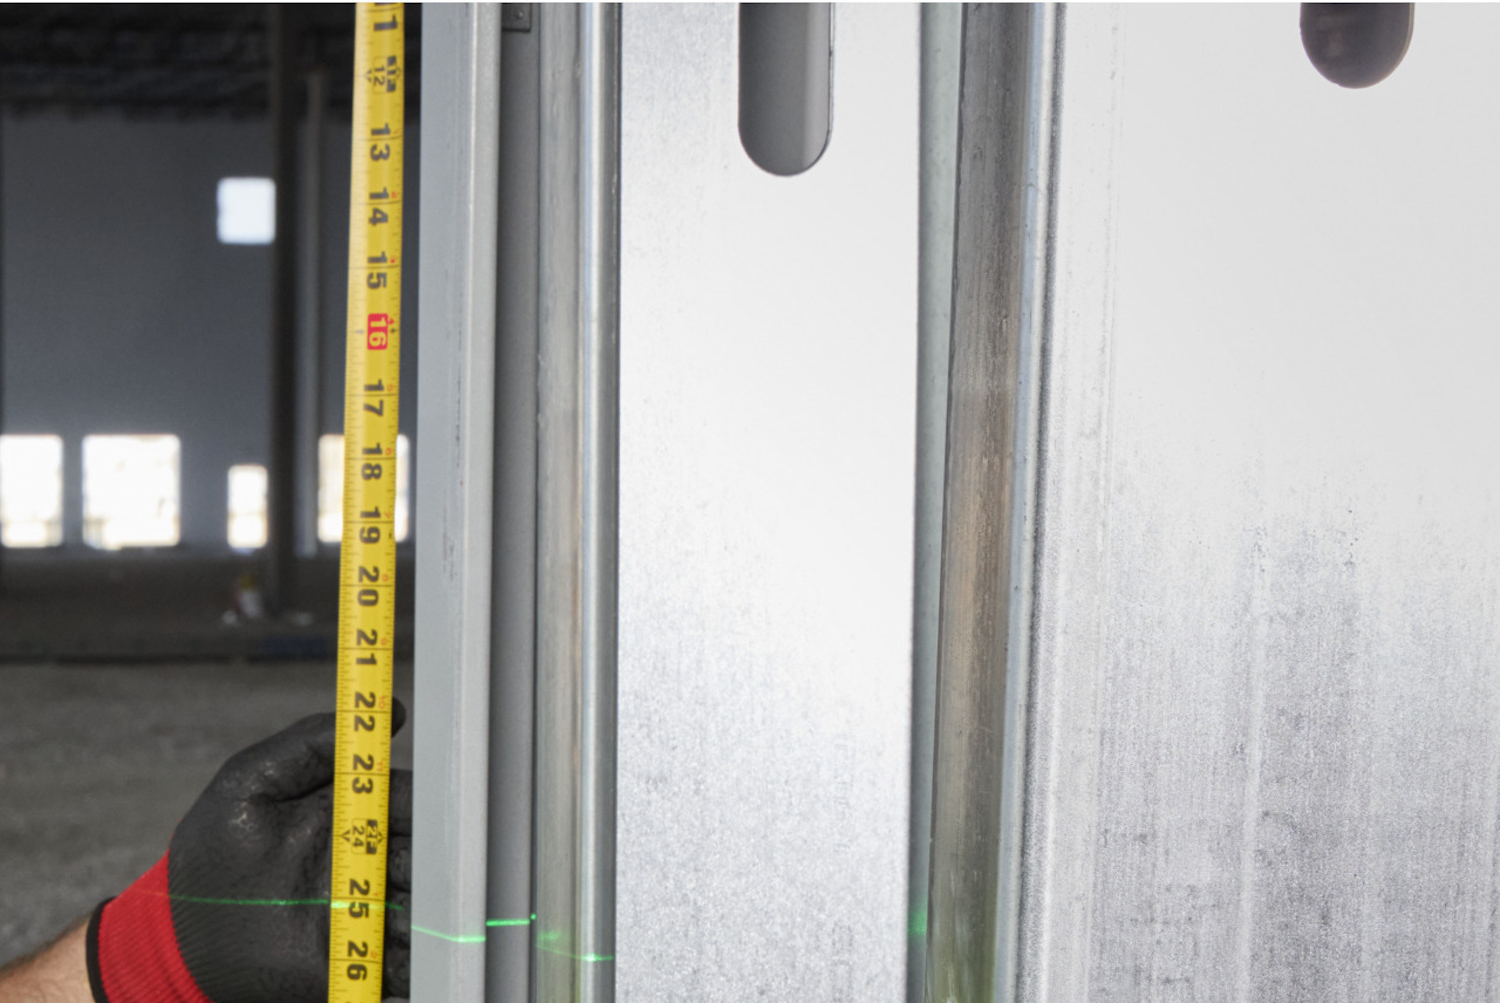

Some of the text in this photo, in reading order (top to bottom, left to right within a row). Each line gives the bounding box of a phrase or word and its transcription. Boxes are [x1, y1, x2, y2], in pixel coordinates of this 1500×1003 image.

[373, 66, 385, 87] 12
[370, 122, 391, 162] 13
[368, 186, 389, 226] 14
[366, 251, 387, 289] 15
[368, 316, 387, 348] 16
[363, 379, 385, 417] 17
[361, 442, 383, 481] 18
[359, 506, 381, 544] 19
[357, 566, 380, 607] 20
[355, 629, 378, 666] 21
[354, 692, 376, 732] 22
[352, 754, 374, 794] 23
[352, 825, 366, 847] 24
[348, 879, 370, 918] 25
[346, 941, 368, 981] 26
